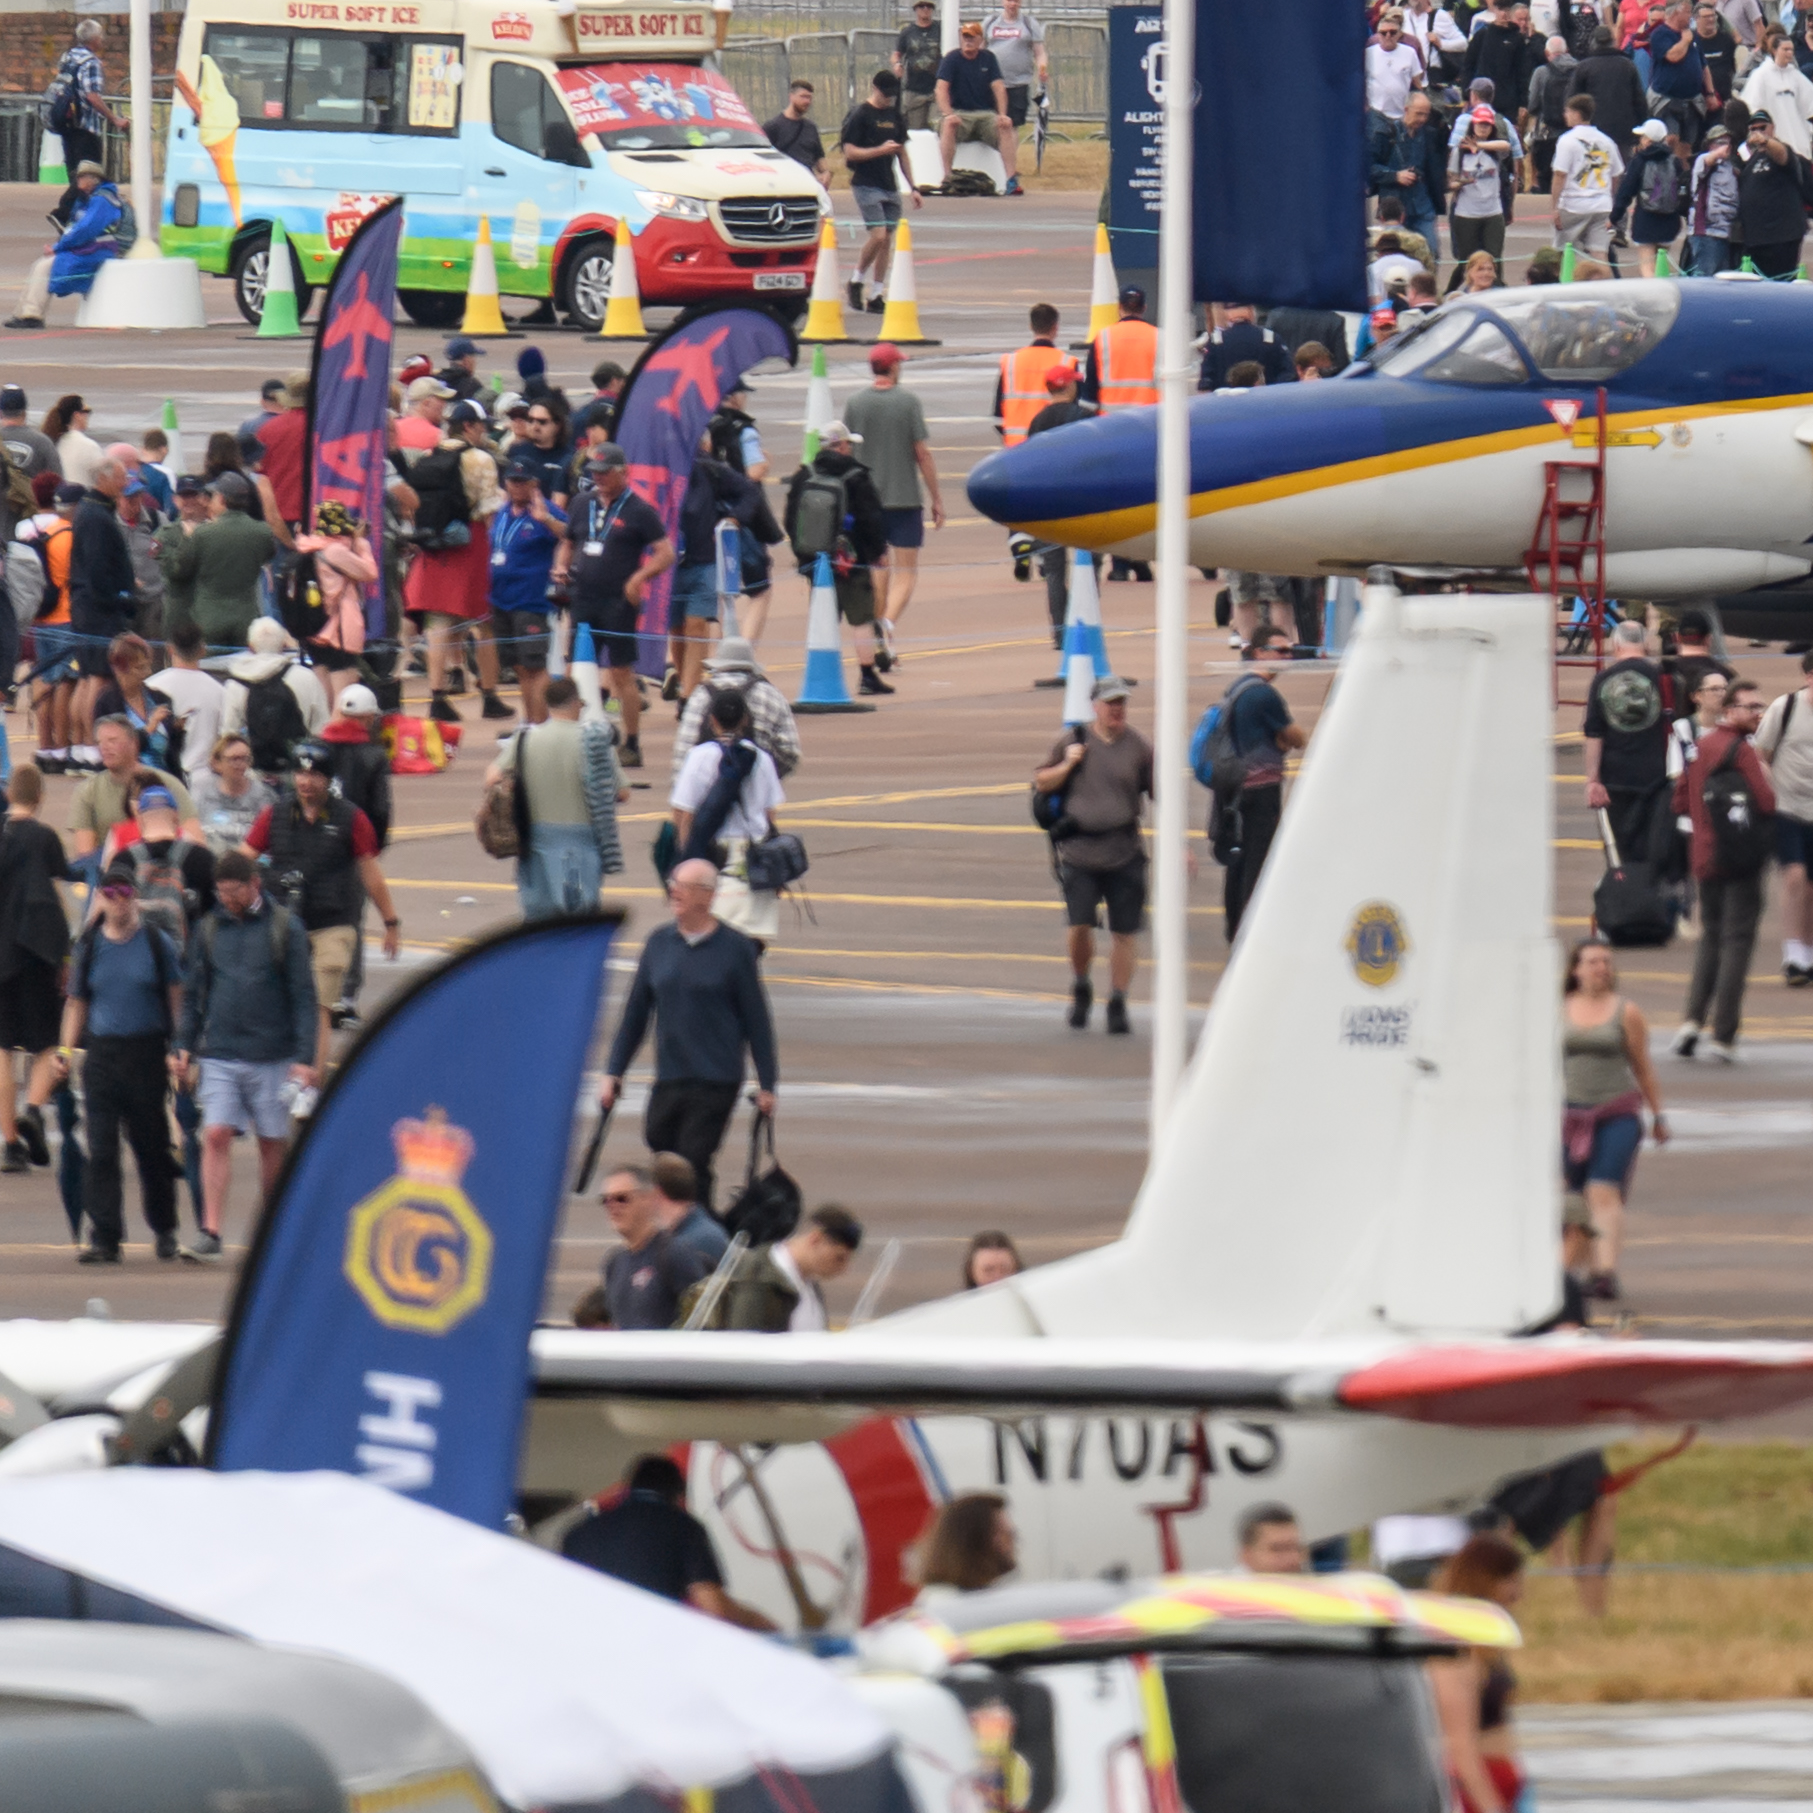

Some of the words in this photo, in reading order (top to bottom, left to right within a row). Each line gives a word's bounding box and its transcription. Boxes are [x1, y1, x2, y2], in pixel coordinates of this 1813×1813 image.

[287, 2, 339, 21] SUPER
[345, 5, 387, 24] SOFT
[391, 6, 421, 25] ICE
[577, 13, 637, 37] SUPER
[640, 13, 679, 36] SOFT
